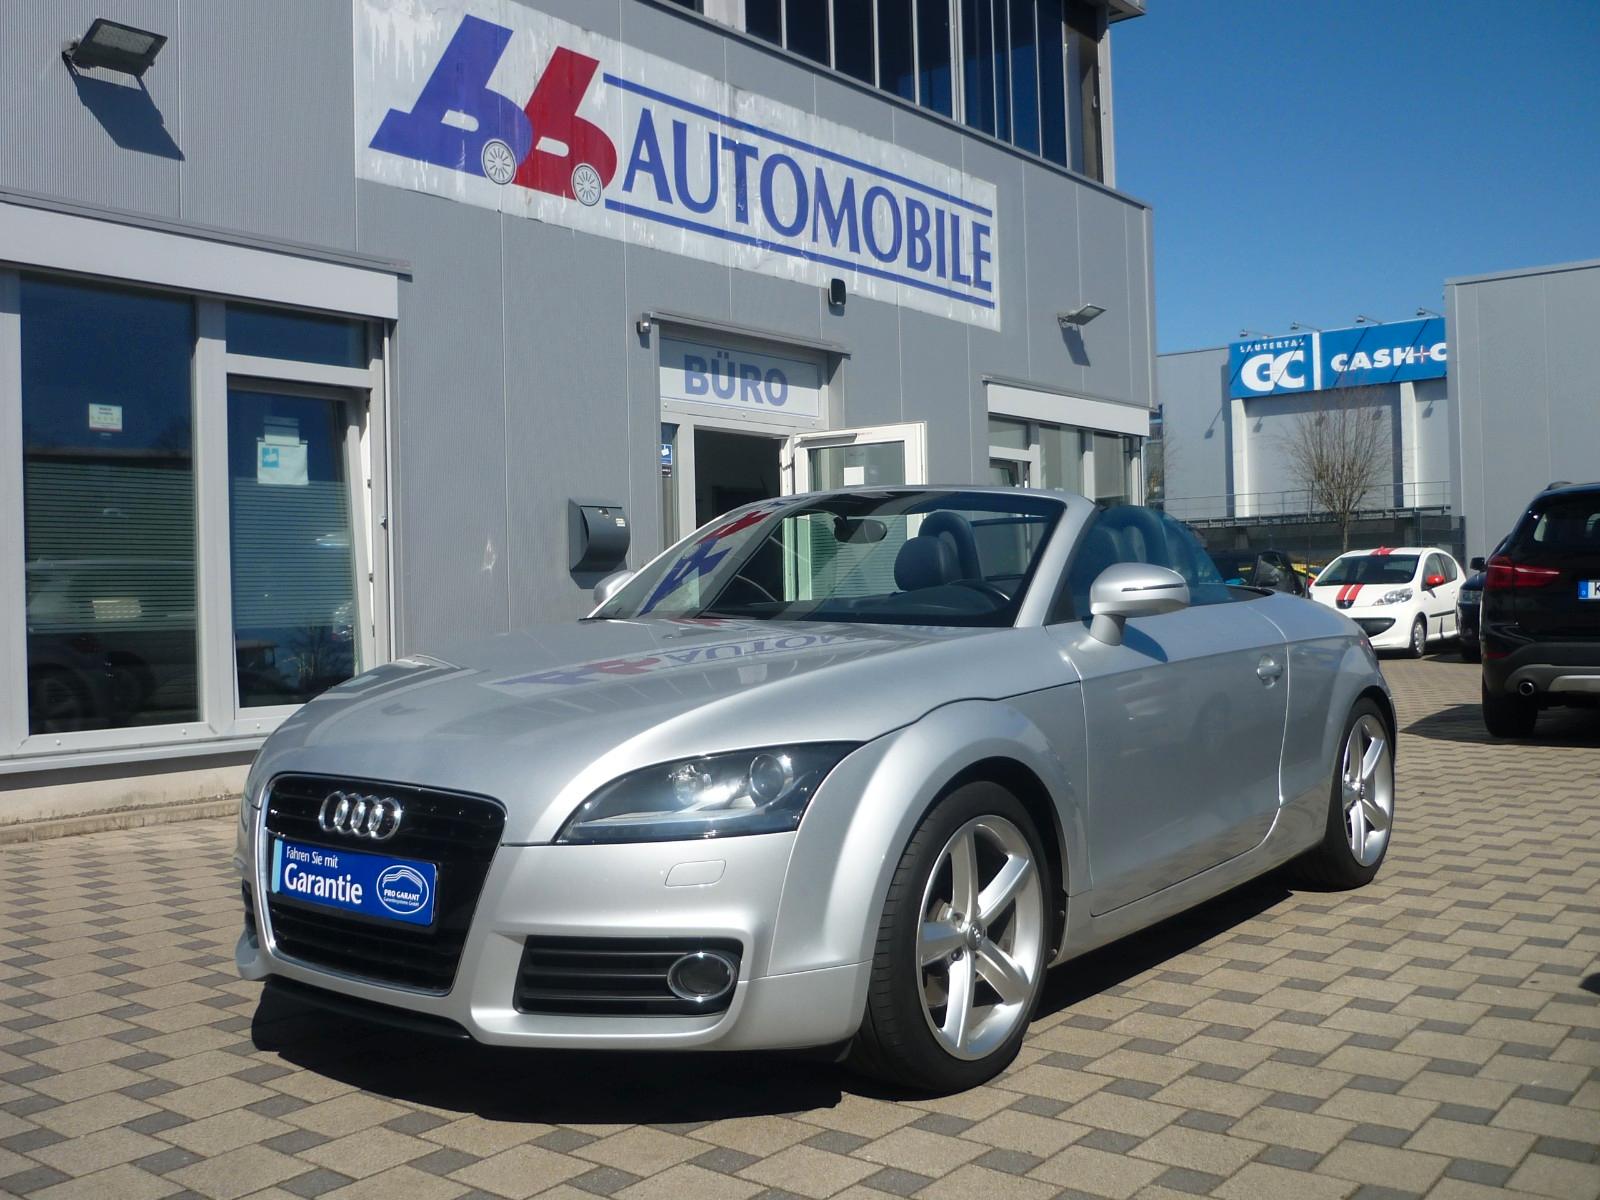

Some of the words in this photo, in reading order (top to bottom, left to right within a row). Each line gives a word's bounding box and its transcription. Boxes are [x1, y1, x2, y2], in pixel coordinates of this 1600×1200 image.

[622, 107, 993, 293] AUTOMOBILE
[1239, 338, 1305, 353] LAUTERTAL
[684, 351, 789, 407] BÜRO
[286, 846, 310, 862] Fahren
[311, 851, 323, 865] Sie
[324, 855, 338, 869] mit
[284, 863, 363, 904] Garantie
[384, 889, 396, 897] PRO
[396, 891, 420, 901] GARANT
